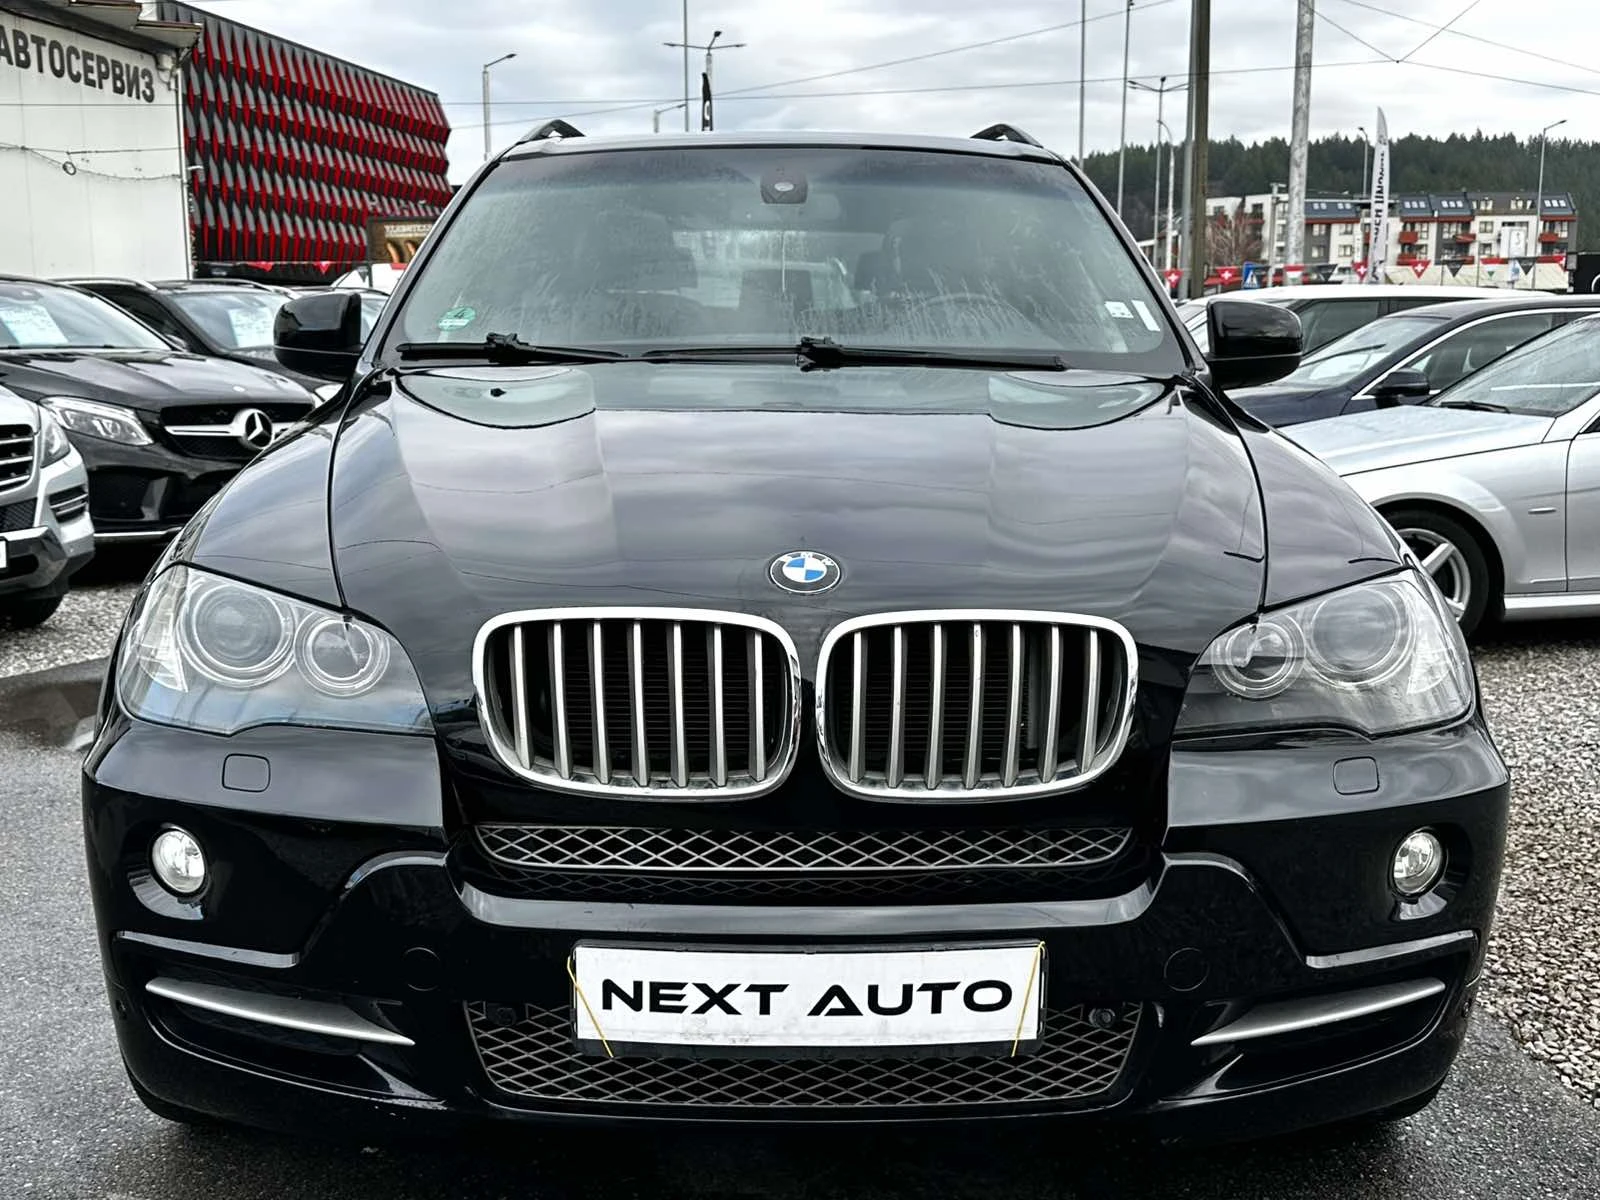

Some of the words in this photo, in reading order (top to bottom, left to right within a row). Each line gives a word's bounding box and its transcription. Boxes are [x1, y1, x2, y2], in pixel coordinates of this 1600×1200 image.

[0, 24, 155, 103] АВТОСЕРВИЗ
[601, 978, 790, 1016] NEXT
[806, 979, 1013, 1017] AUTO
